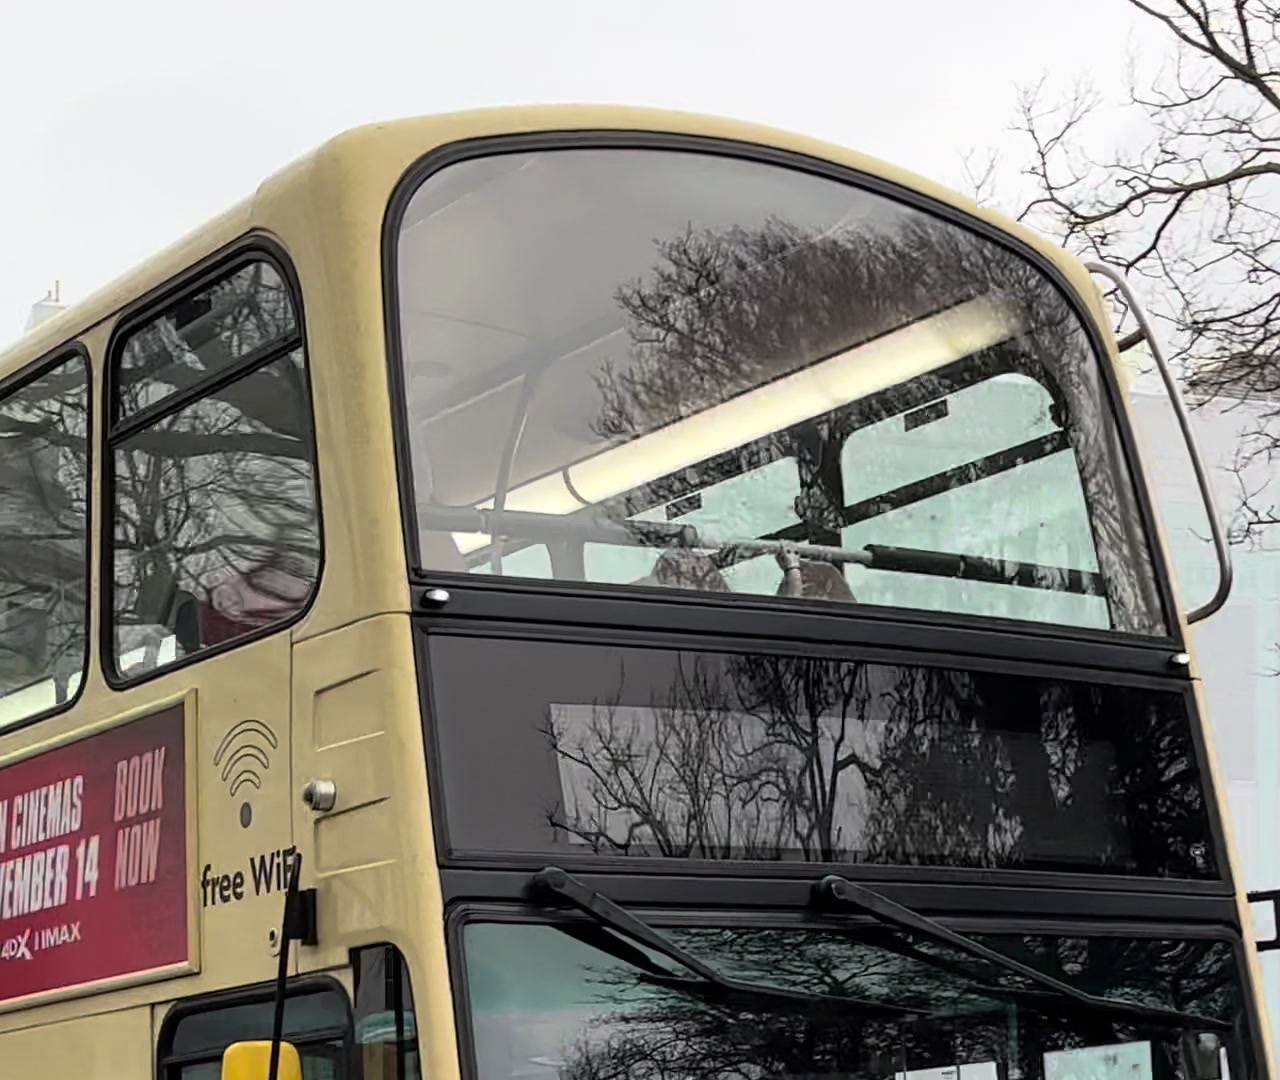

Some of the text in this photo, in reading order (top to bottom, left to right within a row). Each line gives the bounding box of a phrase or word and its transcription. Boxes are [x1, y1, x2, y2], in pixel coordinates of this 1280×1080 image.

[11, 774, 84, 850] CINEMAS
[114, 746, 166, 822] BOOK
[75, 834, 100, 900] 14
[114, 817, 161, 891] NOW
[201, 845, 299, 907] free WiF
[41, 921, 81, 949] IMAX
